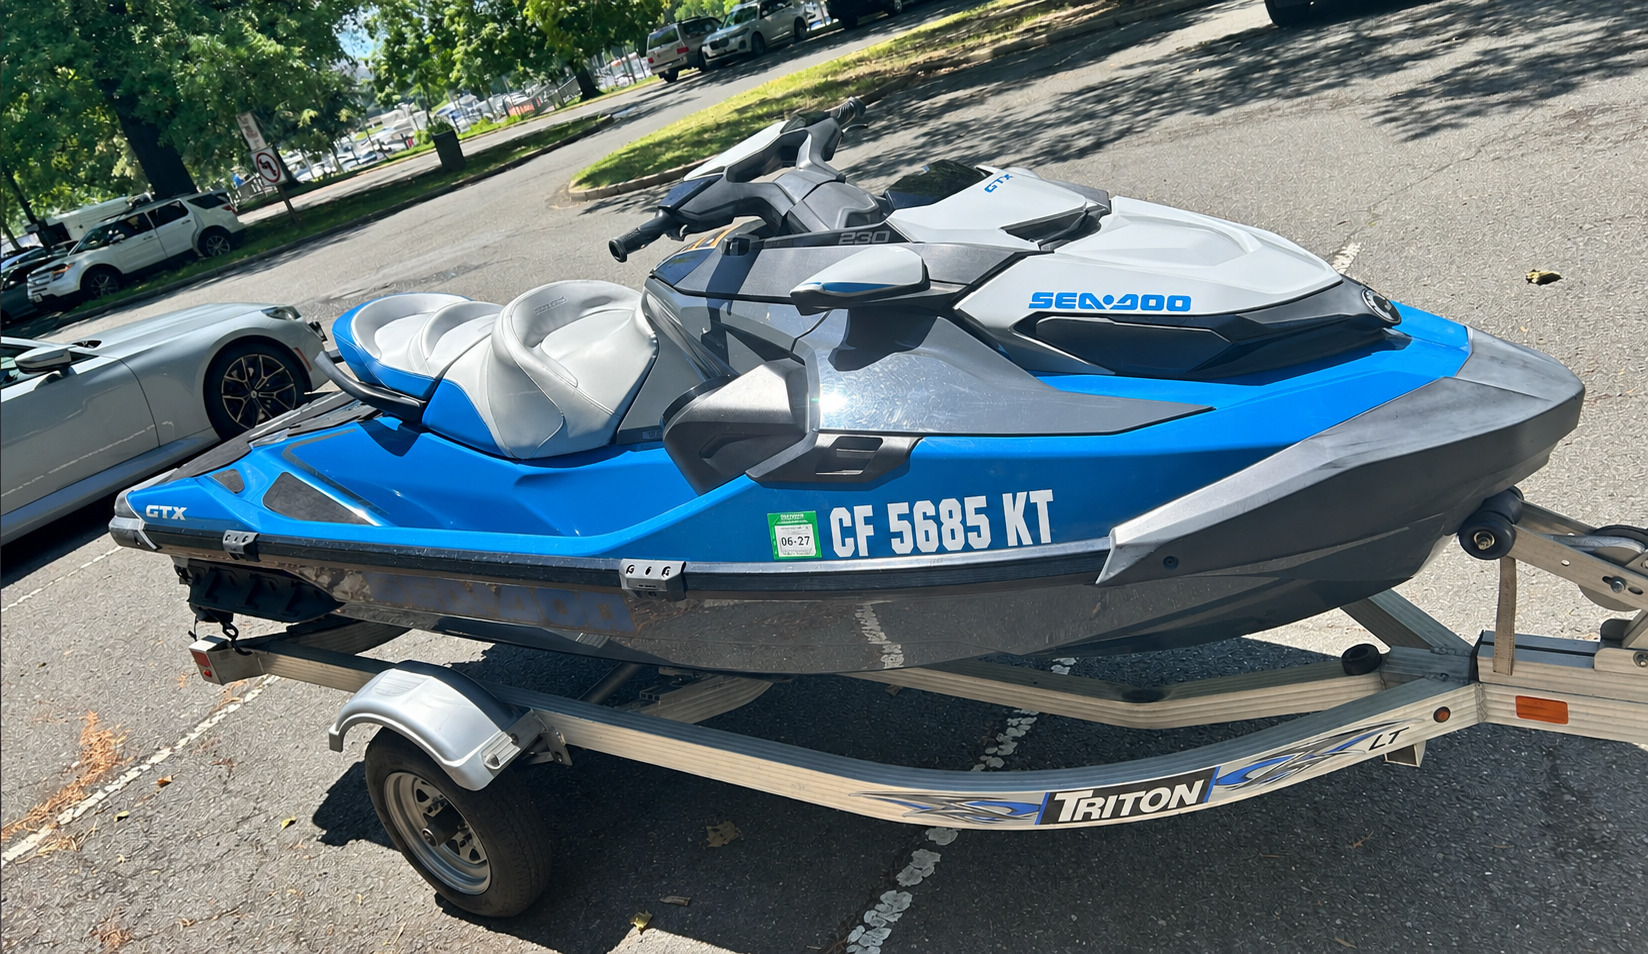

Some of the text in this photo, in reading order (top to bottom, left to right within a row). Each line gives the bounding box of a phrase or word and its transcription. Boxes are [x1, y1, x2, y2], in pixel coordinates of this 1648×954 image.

[984, 173, 1014, 193] GTX
[838, 230, 891, 245] 230
[145, 504, 188, 521] GTX
[829, 489, 1054, 558] CF 5685 KT
[1368, 726, 1410, 751] LT
[1054, 778, 1206, 823] TRITON
